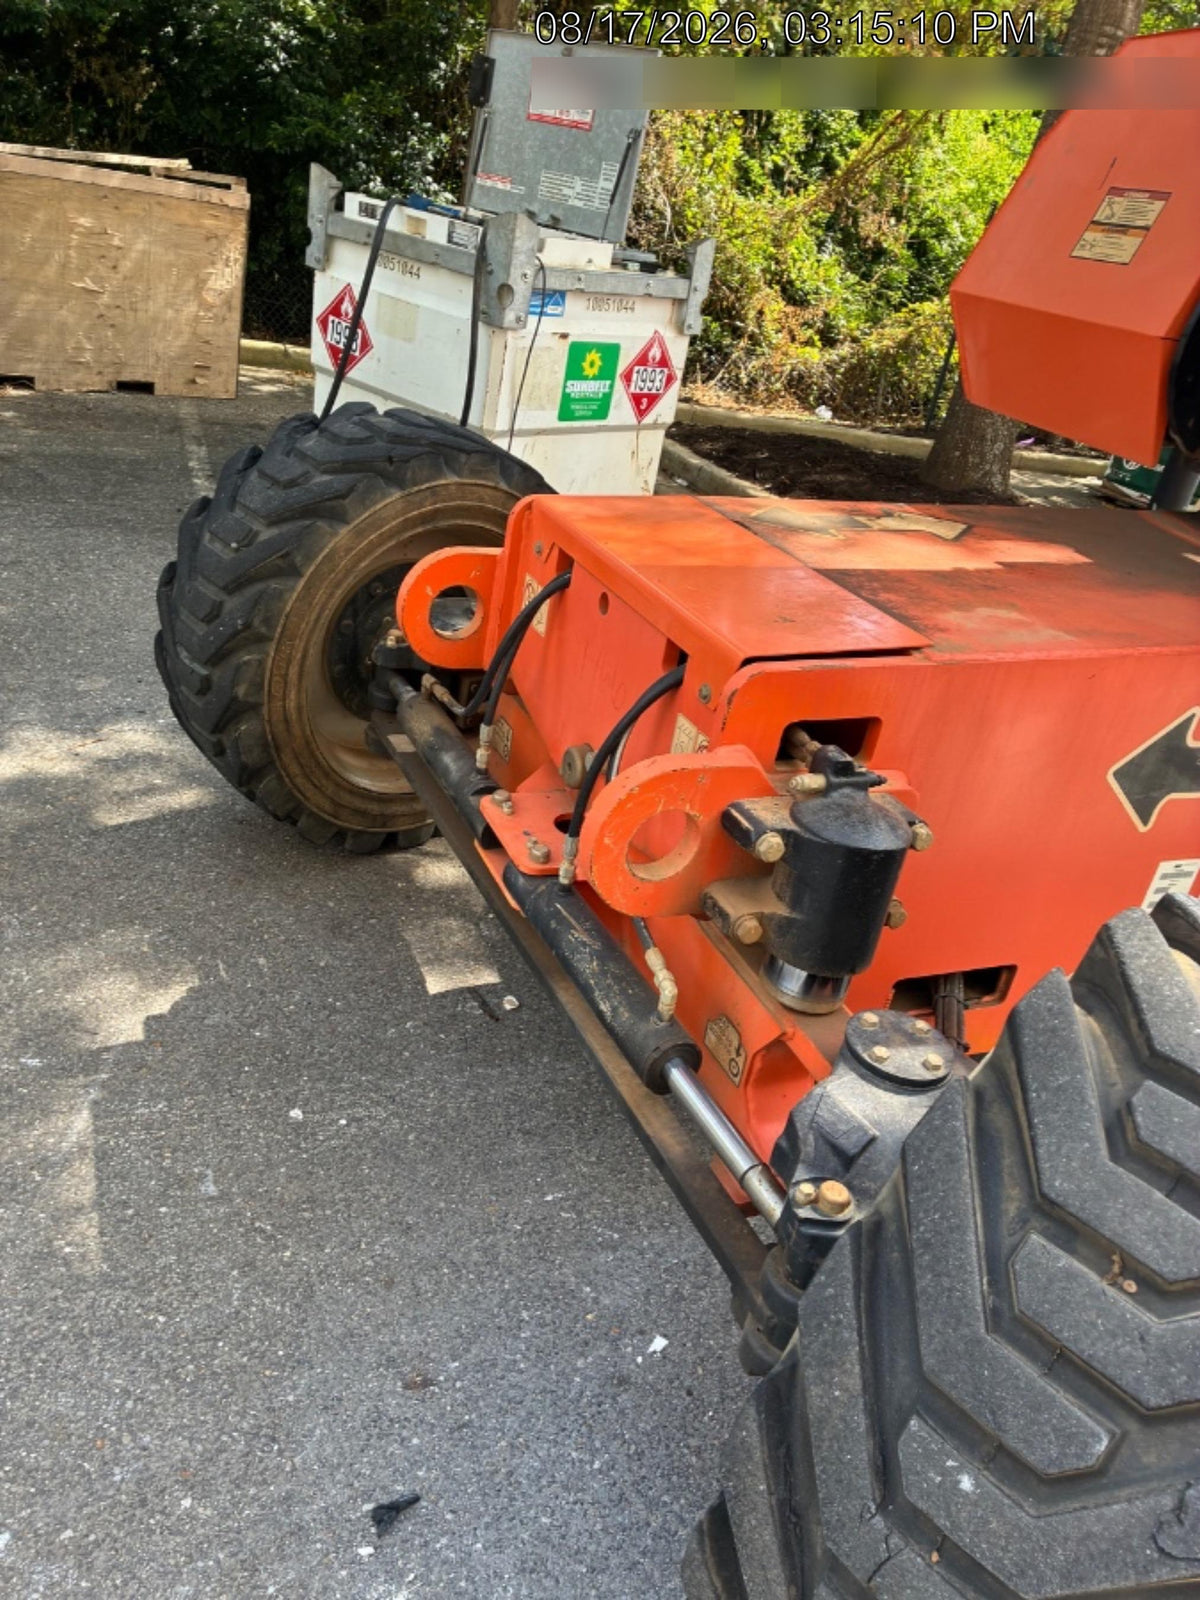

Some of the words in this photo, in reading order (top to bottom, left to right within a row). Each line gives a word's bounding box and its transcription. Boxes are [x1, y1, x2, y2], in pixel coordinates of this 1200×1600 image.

[586, 296, 636, 313] 10051044
[634, 367, 666, 392] 1993
[640, 398, 648, 409] 3
